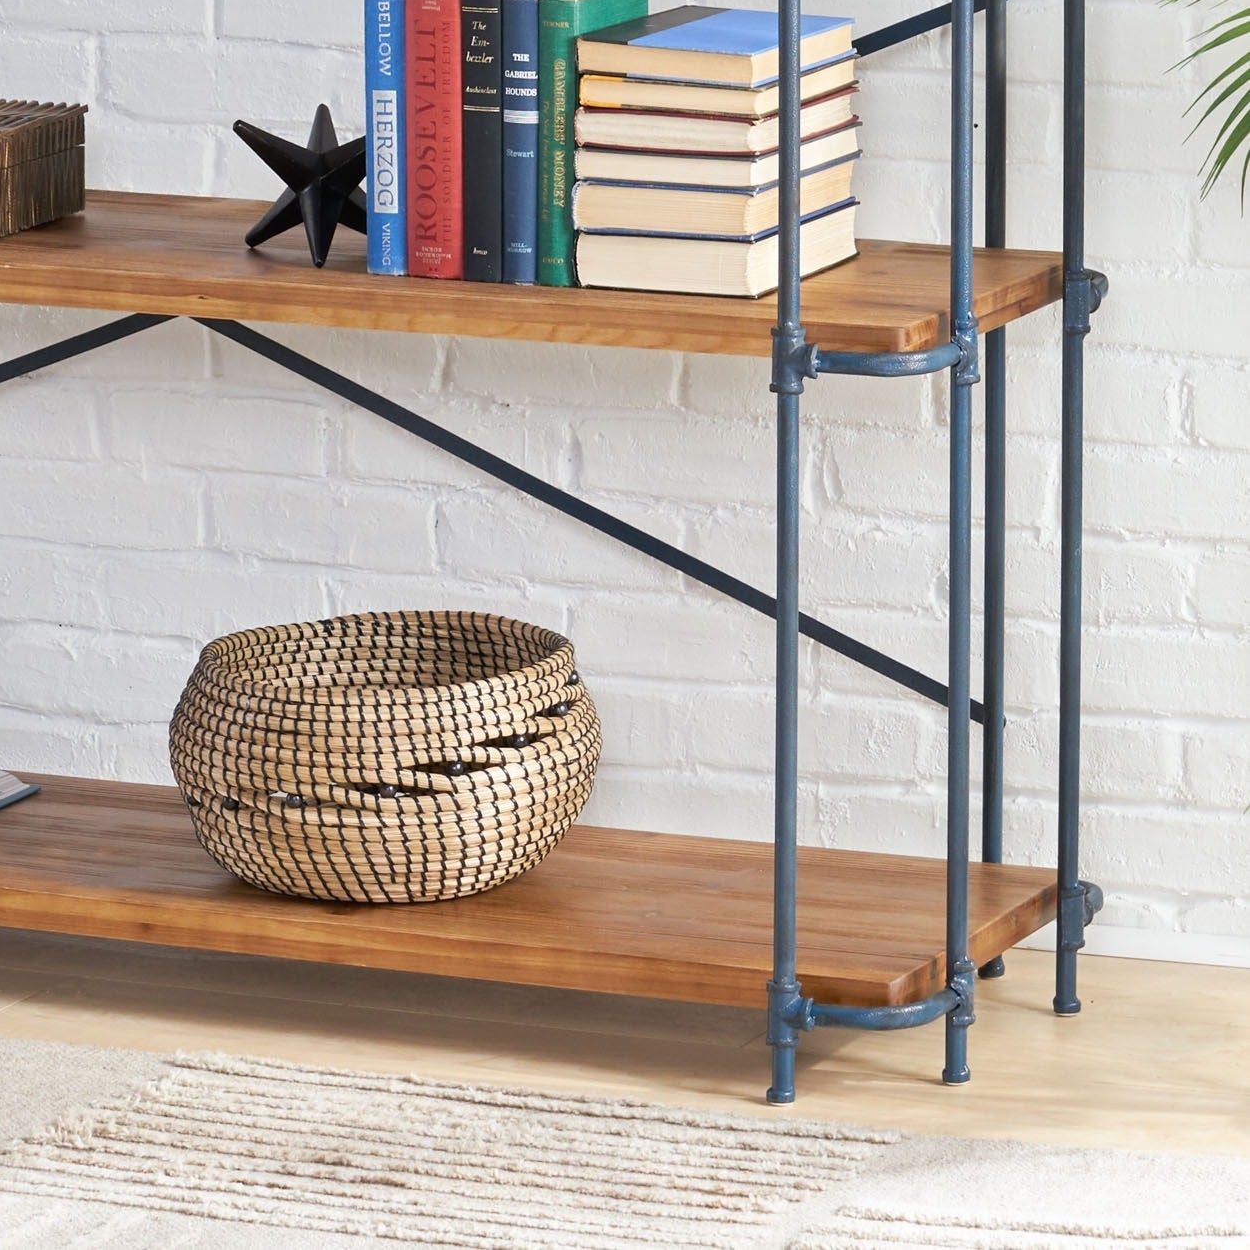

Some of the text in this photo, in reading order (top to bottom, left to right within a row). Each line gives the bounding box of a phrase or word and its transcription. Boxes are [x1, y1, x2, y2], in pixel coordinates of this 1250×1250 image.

[472, 21, 487, 31] The
[377, 1, 392, 77] BELLOW
[470, 35, 490, 47] Em-
[465, 51, 495, 64] bezzler
[512, 53, 530, 62] THE
[504, 69, 538, 80] GABRIEL
[505, 87, 538, 97] HOUNDS
[414, 18, 439, 243] ROOSEVELT
[376, 99, 394, 207] HERZOG
[506, 148, 535, 158] Stewart
[553, 150, 566, 208] MONEY
[381, 222, 392, 266] VIKING
